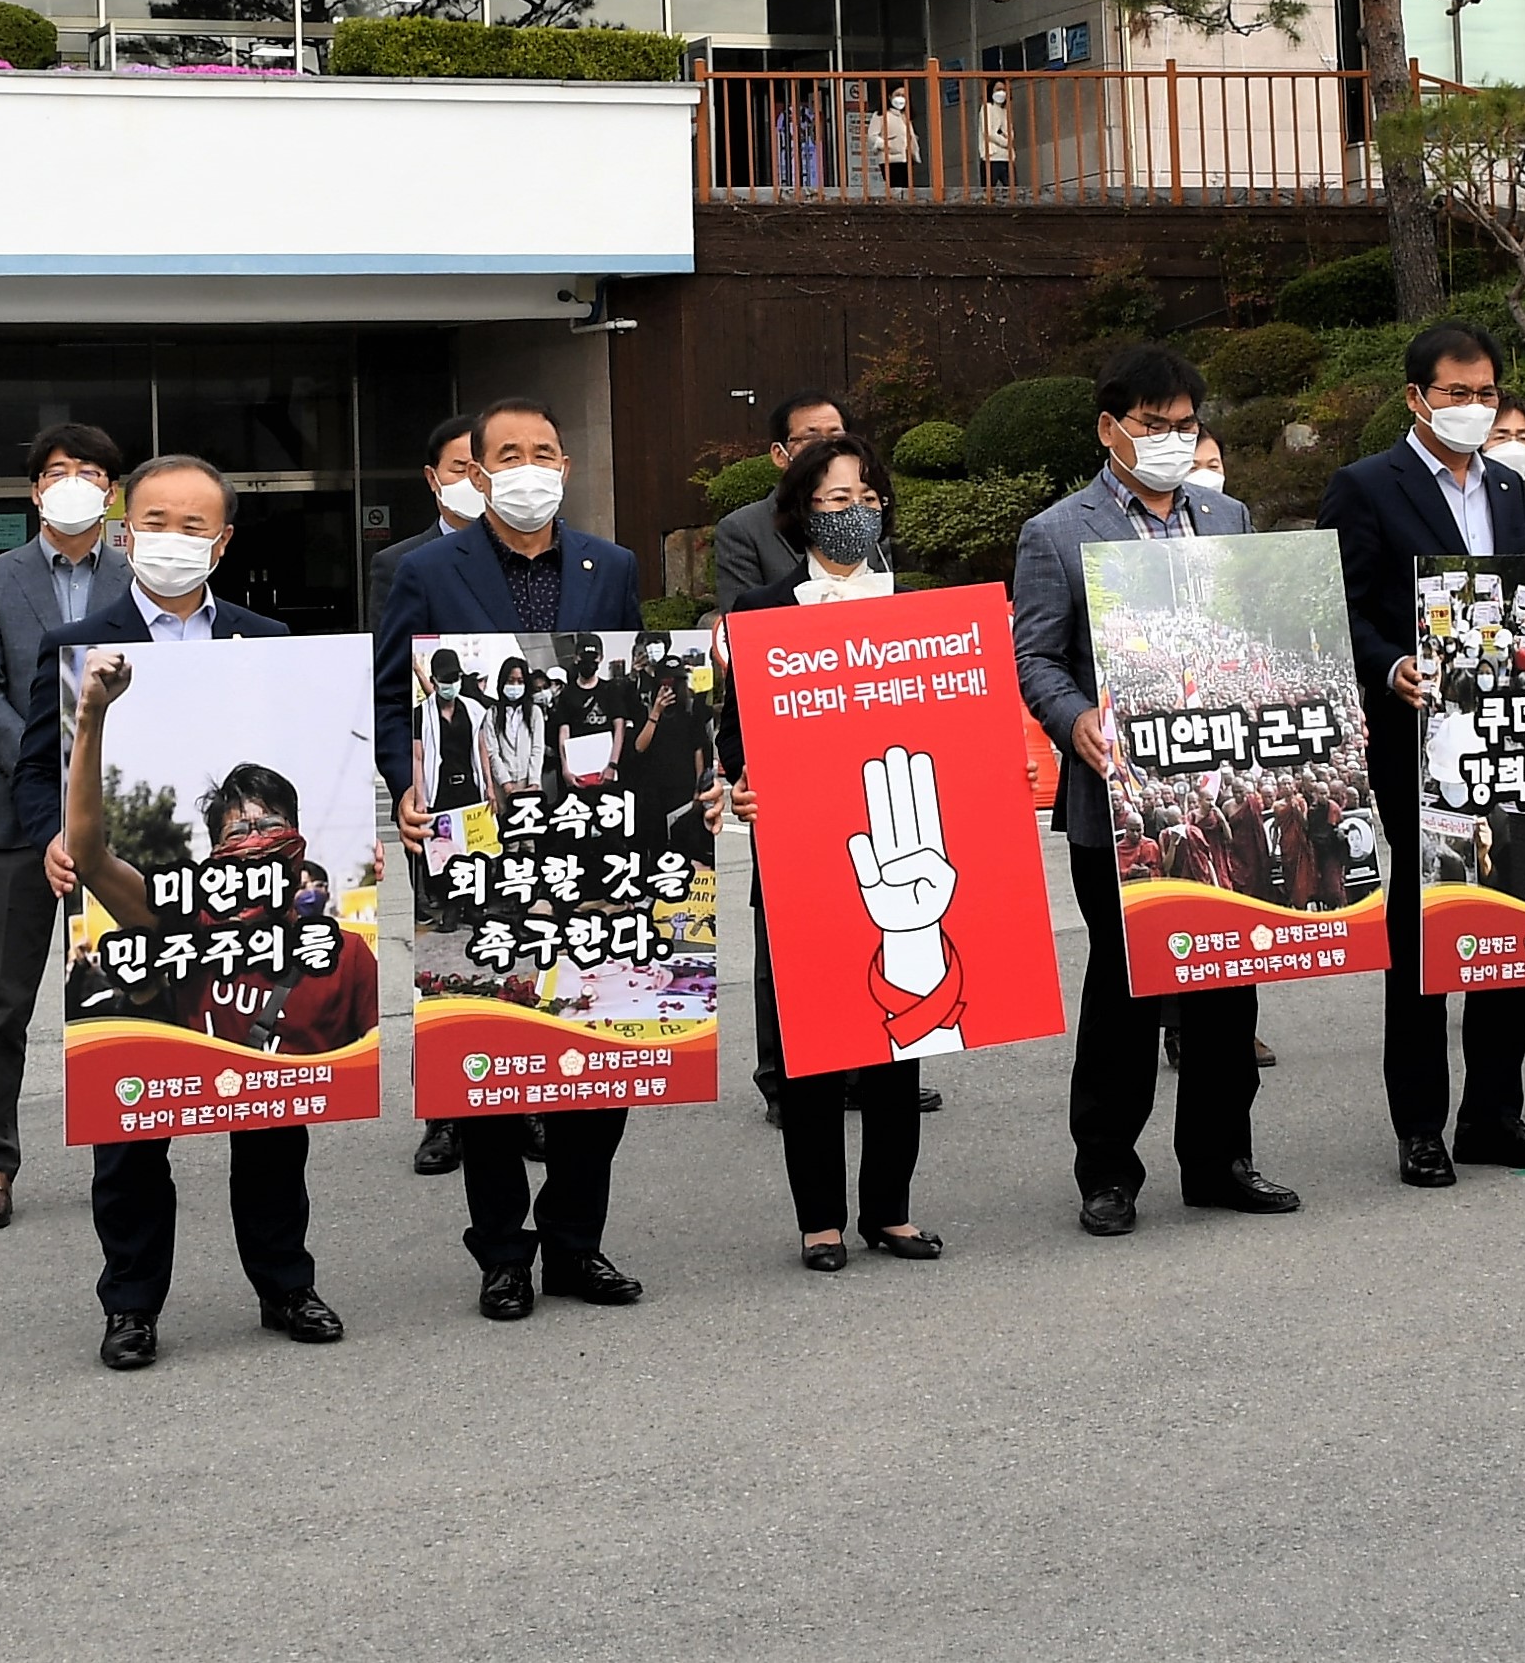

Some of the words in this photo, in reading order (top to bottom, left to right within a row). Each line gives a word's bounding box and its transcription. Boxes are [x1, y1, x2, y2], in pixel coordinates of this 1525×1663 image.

[767, 647, 839, 679] Save
[844, 621, 983, 670] Myanmar!
[772, 684, 848, 719] 미얀마
[852, 675, 926, 710] 쿠테타
[931, 667, 989, 701] 반대!
[1130, 710, 1250, 767] 미얀마
[1257, 706, 1335, 759] 군부
[502, 791, 637, 839] 조속히
[153, 862, 289, 915] 미얀마
[447, 854, 586, 906] 회복할
[601, 851, 692, 900] 것을
[106, 924, 336, 984] 민주주의를
[470, 912, 669, 968] 촉구한다.
[1194, 931, 1241, 953] 함평군
[1274, 921, 1348, 944] 함평군의회
[1478, 935, 1517, 955] 함평군
[1175, 962, 1220, 983] 동남아
[1224, 953, 1312, 978] 결혼이주여성
[1316, 949, 1346, 967] 일동
[1459, 965, 1497, 983] 동남아
[147, 1076, 203, 1098] 함평군
[245, 1066, 332, 1090] 함평군의회
[493, 1055, 547, 1076] 함평군
[587, 1048, 672, 1071] 함평군의회
[467, 1086, 520, 1107] 동남아
[525, 1080, 628, 1103] 결혼이주여성
[633, 1077, 668, 1097] 일동
[120, 1110, 175, 1132] 동남아
[180, 1100, 286, 1125] 결혼이주여성
[292, 1096, 327, 1115] 일동
